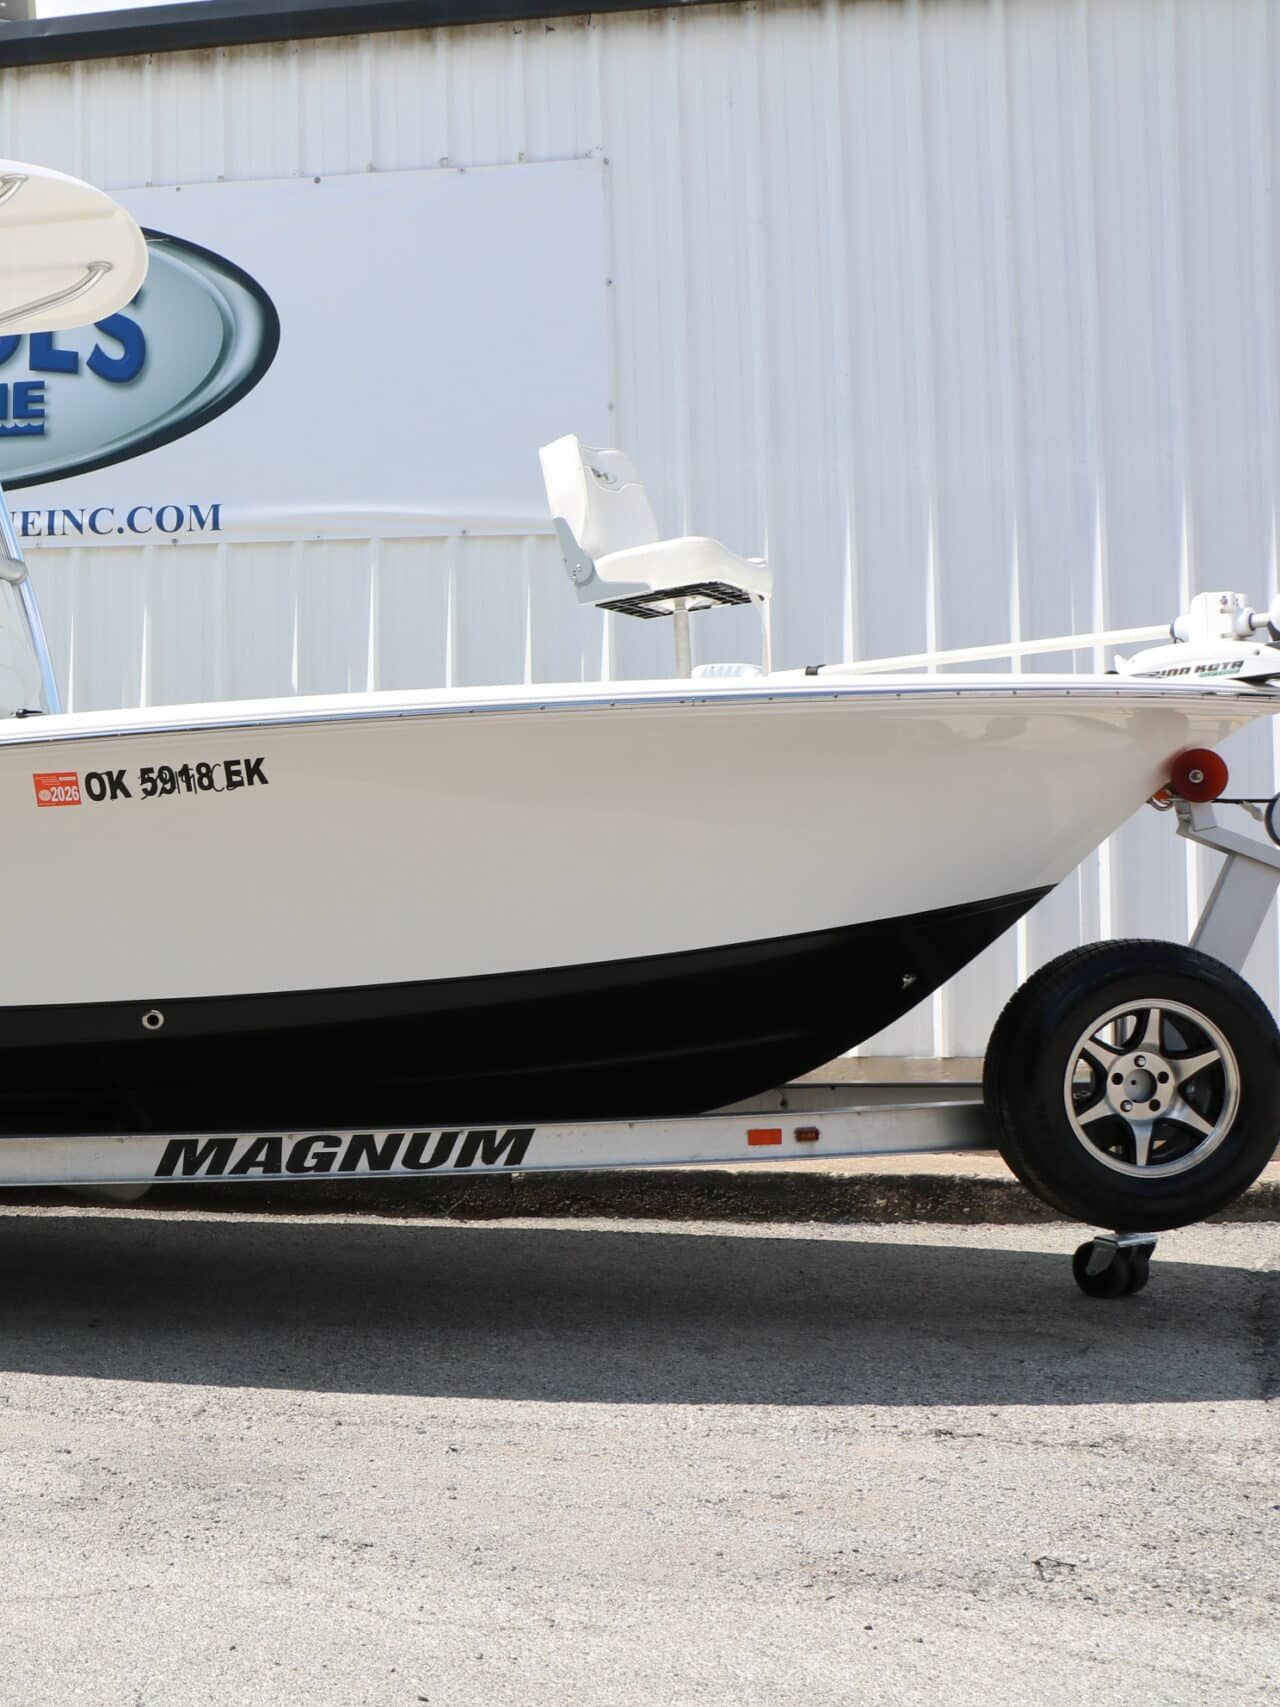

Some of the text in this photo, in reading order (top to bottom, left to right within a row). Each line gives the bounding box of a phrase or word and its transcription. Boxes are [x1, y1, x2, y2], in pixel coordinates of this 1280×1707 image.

[50, 786, 80, 802] 2026
[84, 768, 132, 801] OK
[139, 762, 213, 798] 5918
[223, 757, 269, 790] EK
[154, 1127, 536, 1177] MAGNUM
